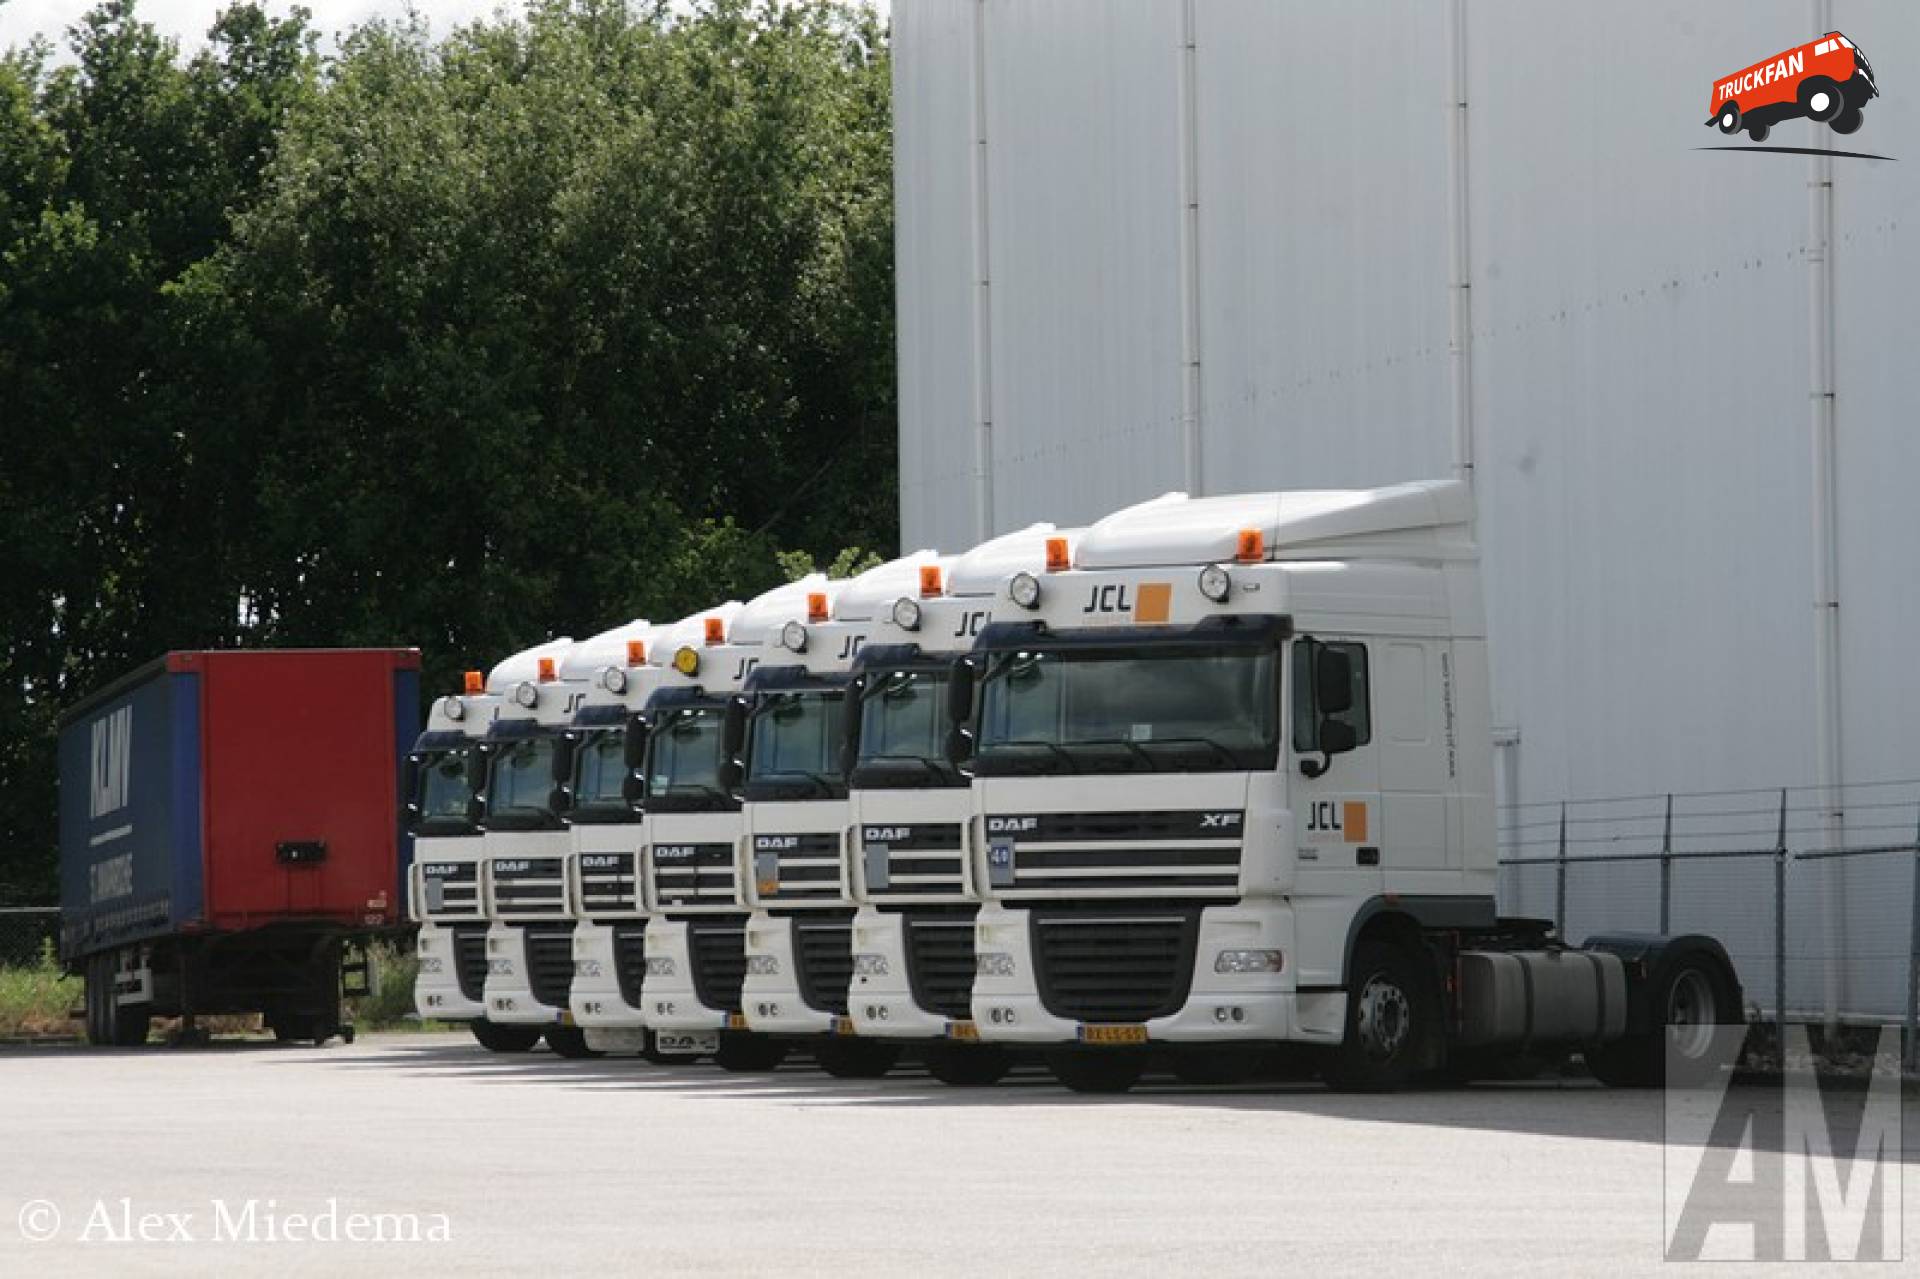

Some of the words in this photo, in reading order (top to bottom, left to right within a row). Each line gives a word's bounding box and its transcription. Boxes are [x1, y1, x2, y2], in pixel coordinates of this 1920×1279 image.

[1082, 584, 1131, 613] JCL
[1200, 813, 1242, 827] XF
[1306, 800, 1343, 831] JCL
[988, 817, 1038, 831] DAF
[864, 827, 911, 841] DAF
[756, 836, 799, 848] DAF
[656, 846, 695, 858] DAF
[582, 856, 619, 867] DAF
